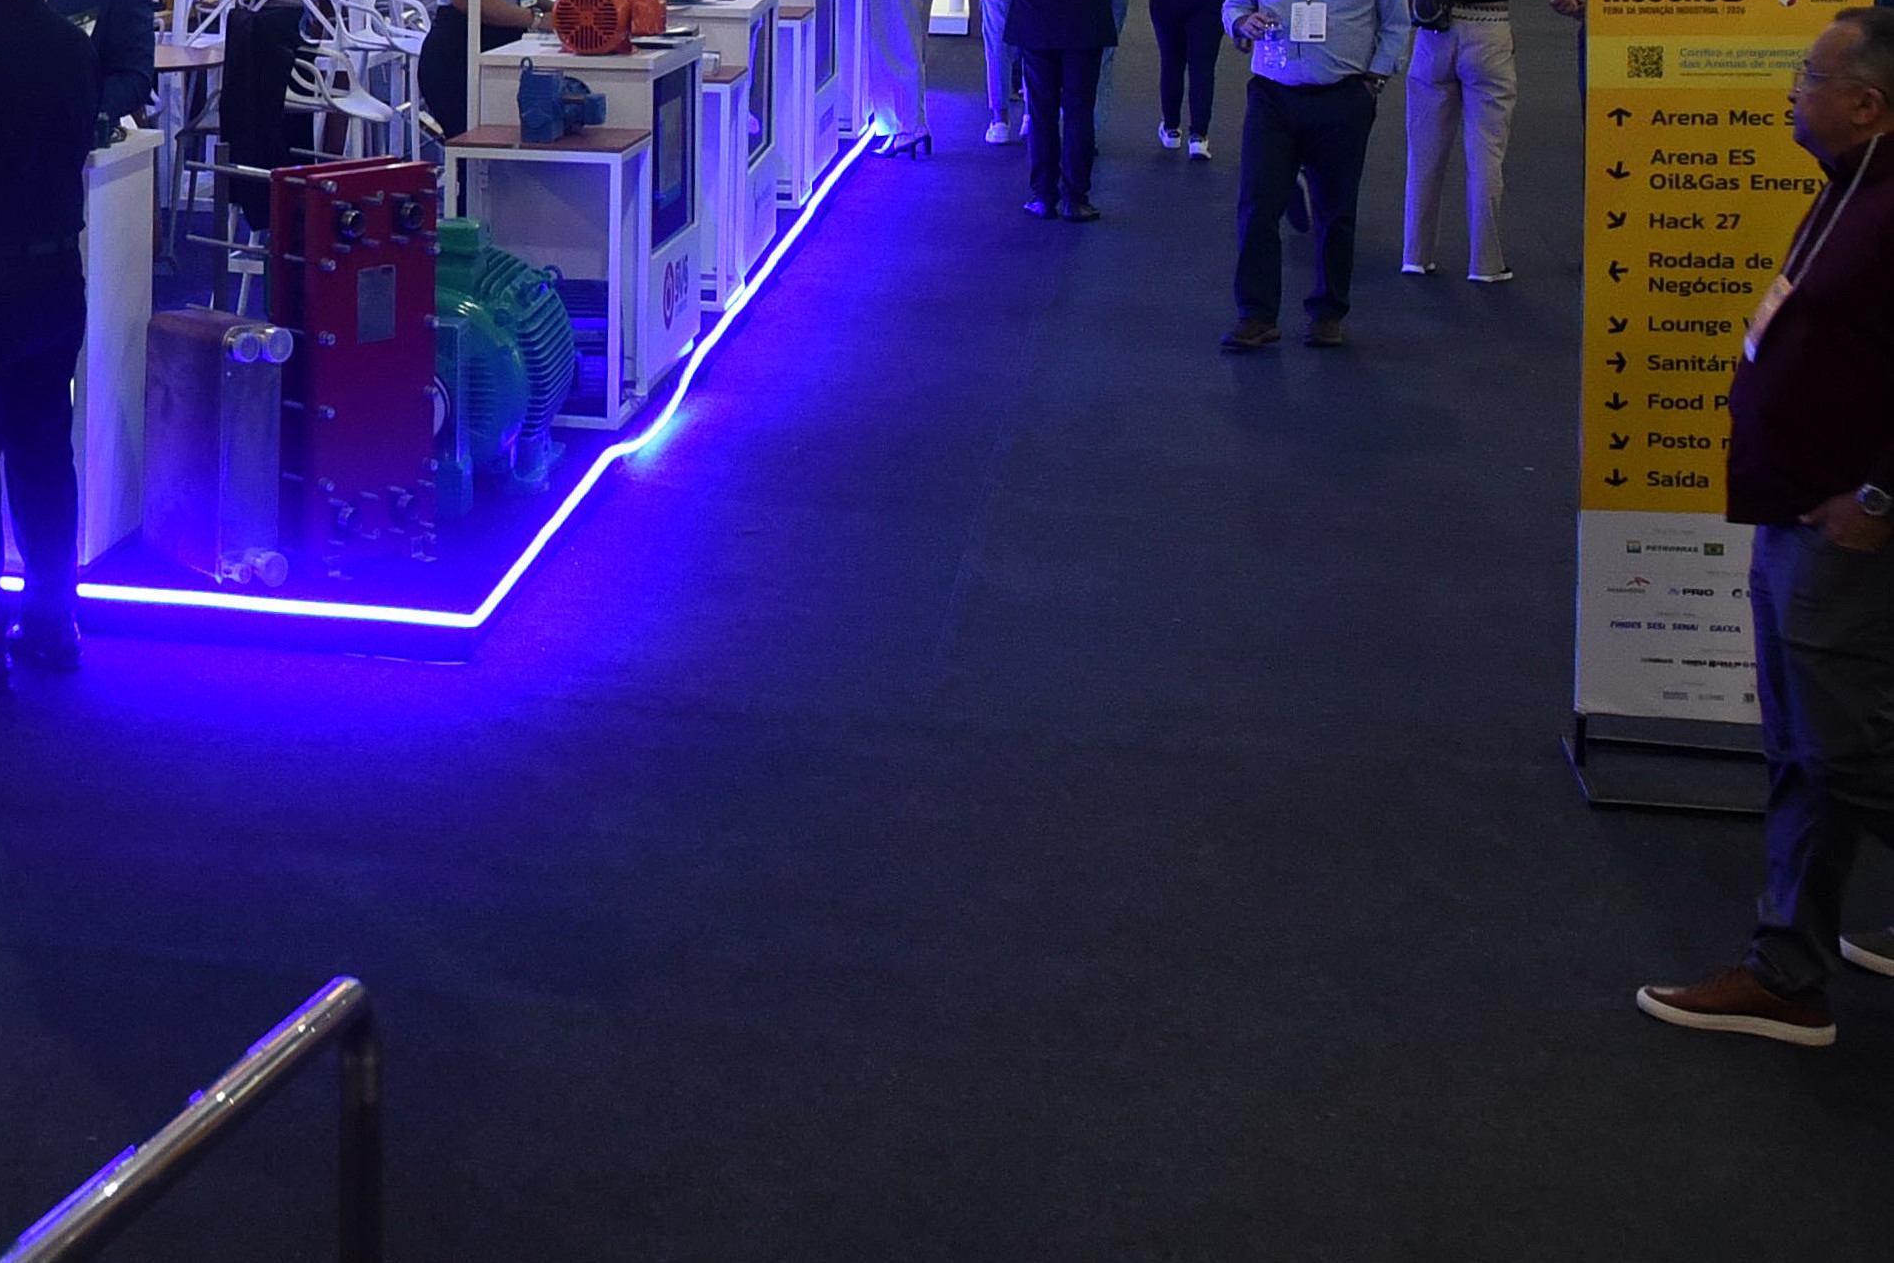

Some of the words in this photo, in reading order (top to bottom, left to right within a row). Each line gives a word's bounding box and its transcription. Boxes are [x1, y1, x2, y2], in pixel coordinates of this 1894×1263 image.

[1651, 109, 1719, 126] Arena
[1729, 109, 1774, 126] Mec
[1650, 148, 1718, 165] Arena
[1728, 149, 1756, 165] ES
[1649, 173, 1740, 190] Oil&Gas
[1649, 213, 1705, 230] Hack
[1715, 213, 1741, 230] 27
[1648, 252, 1735, 269] Rodada
[1745, 252, 1773, 269] de
[1648, 275, 1753, 297] Negócios
[1648, 316, 1732, 336] Lounge
[1647, 354, 1737, 372] Sanitári
[1648, 394, 1704, 410] Food
[1647, 433, 1711, 450] Posto
[1647, 470, 1709, 489] Saída
